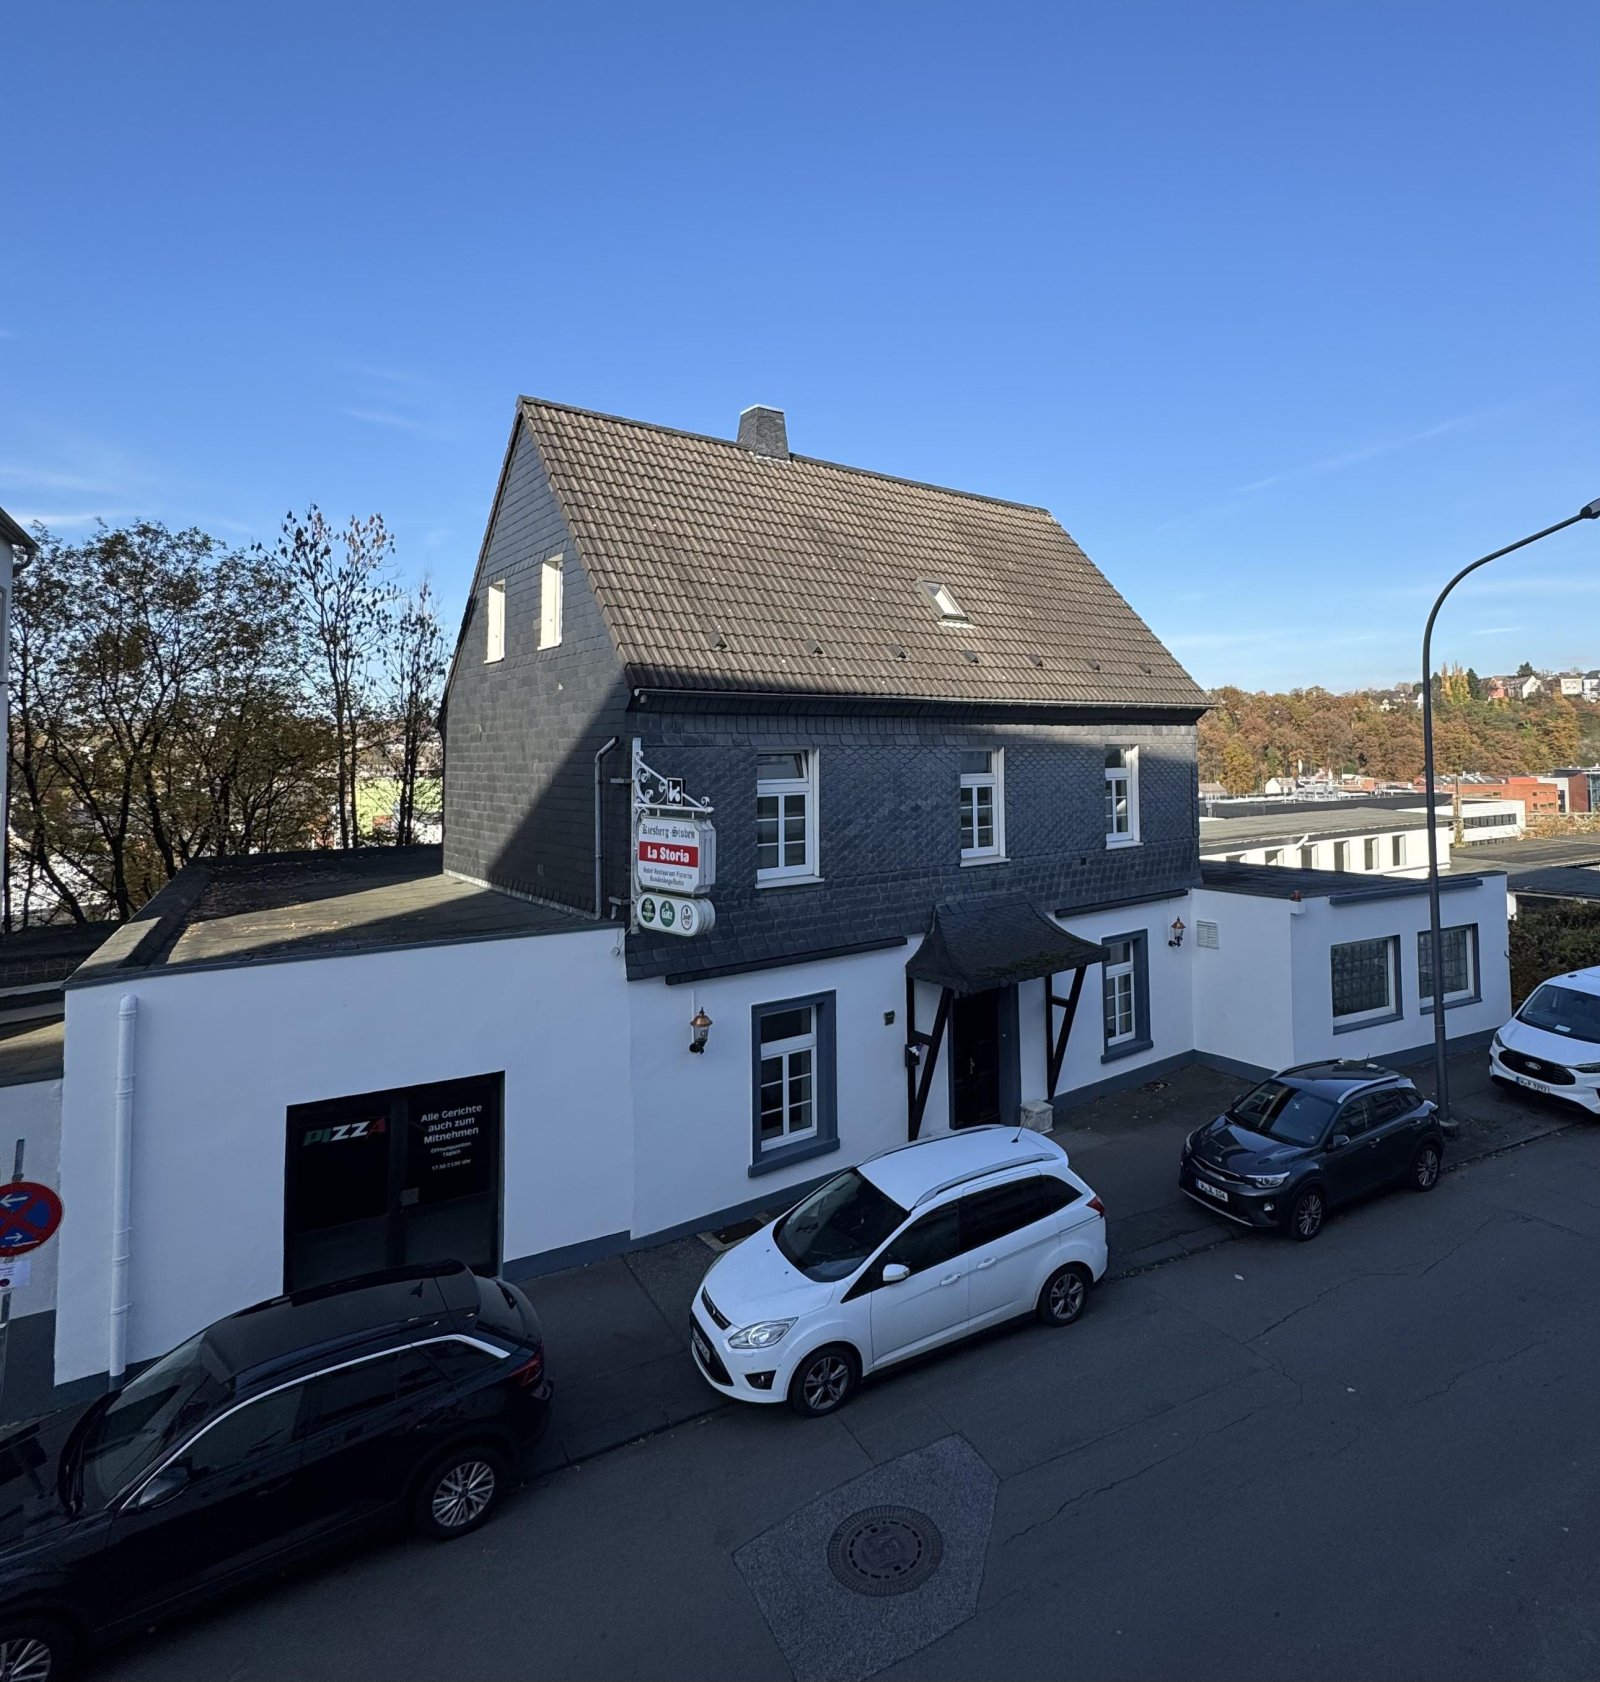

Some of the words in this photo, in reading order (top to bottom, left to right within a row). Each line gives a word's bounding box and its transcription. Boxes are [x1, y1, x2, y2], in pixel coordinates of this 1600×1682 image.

[647, 845, 658, 860] La
[659, 846, 690, 864] Storia
[420, 1113, 440, 1123] Alle
[441, 1104, 483, 1119] Gerichte
[428, 1121, 452, 1133] auch
[454, 1117, 475, 1128] zum
[423, 1127, 479, 1144] Mitnehmen
